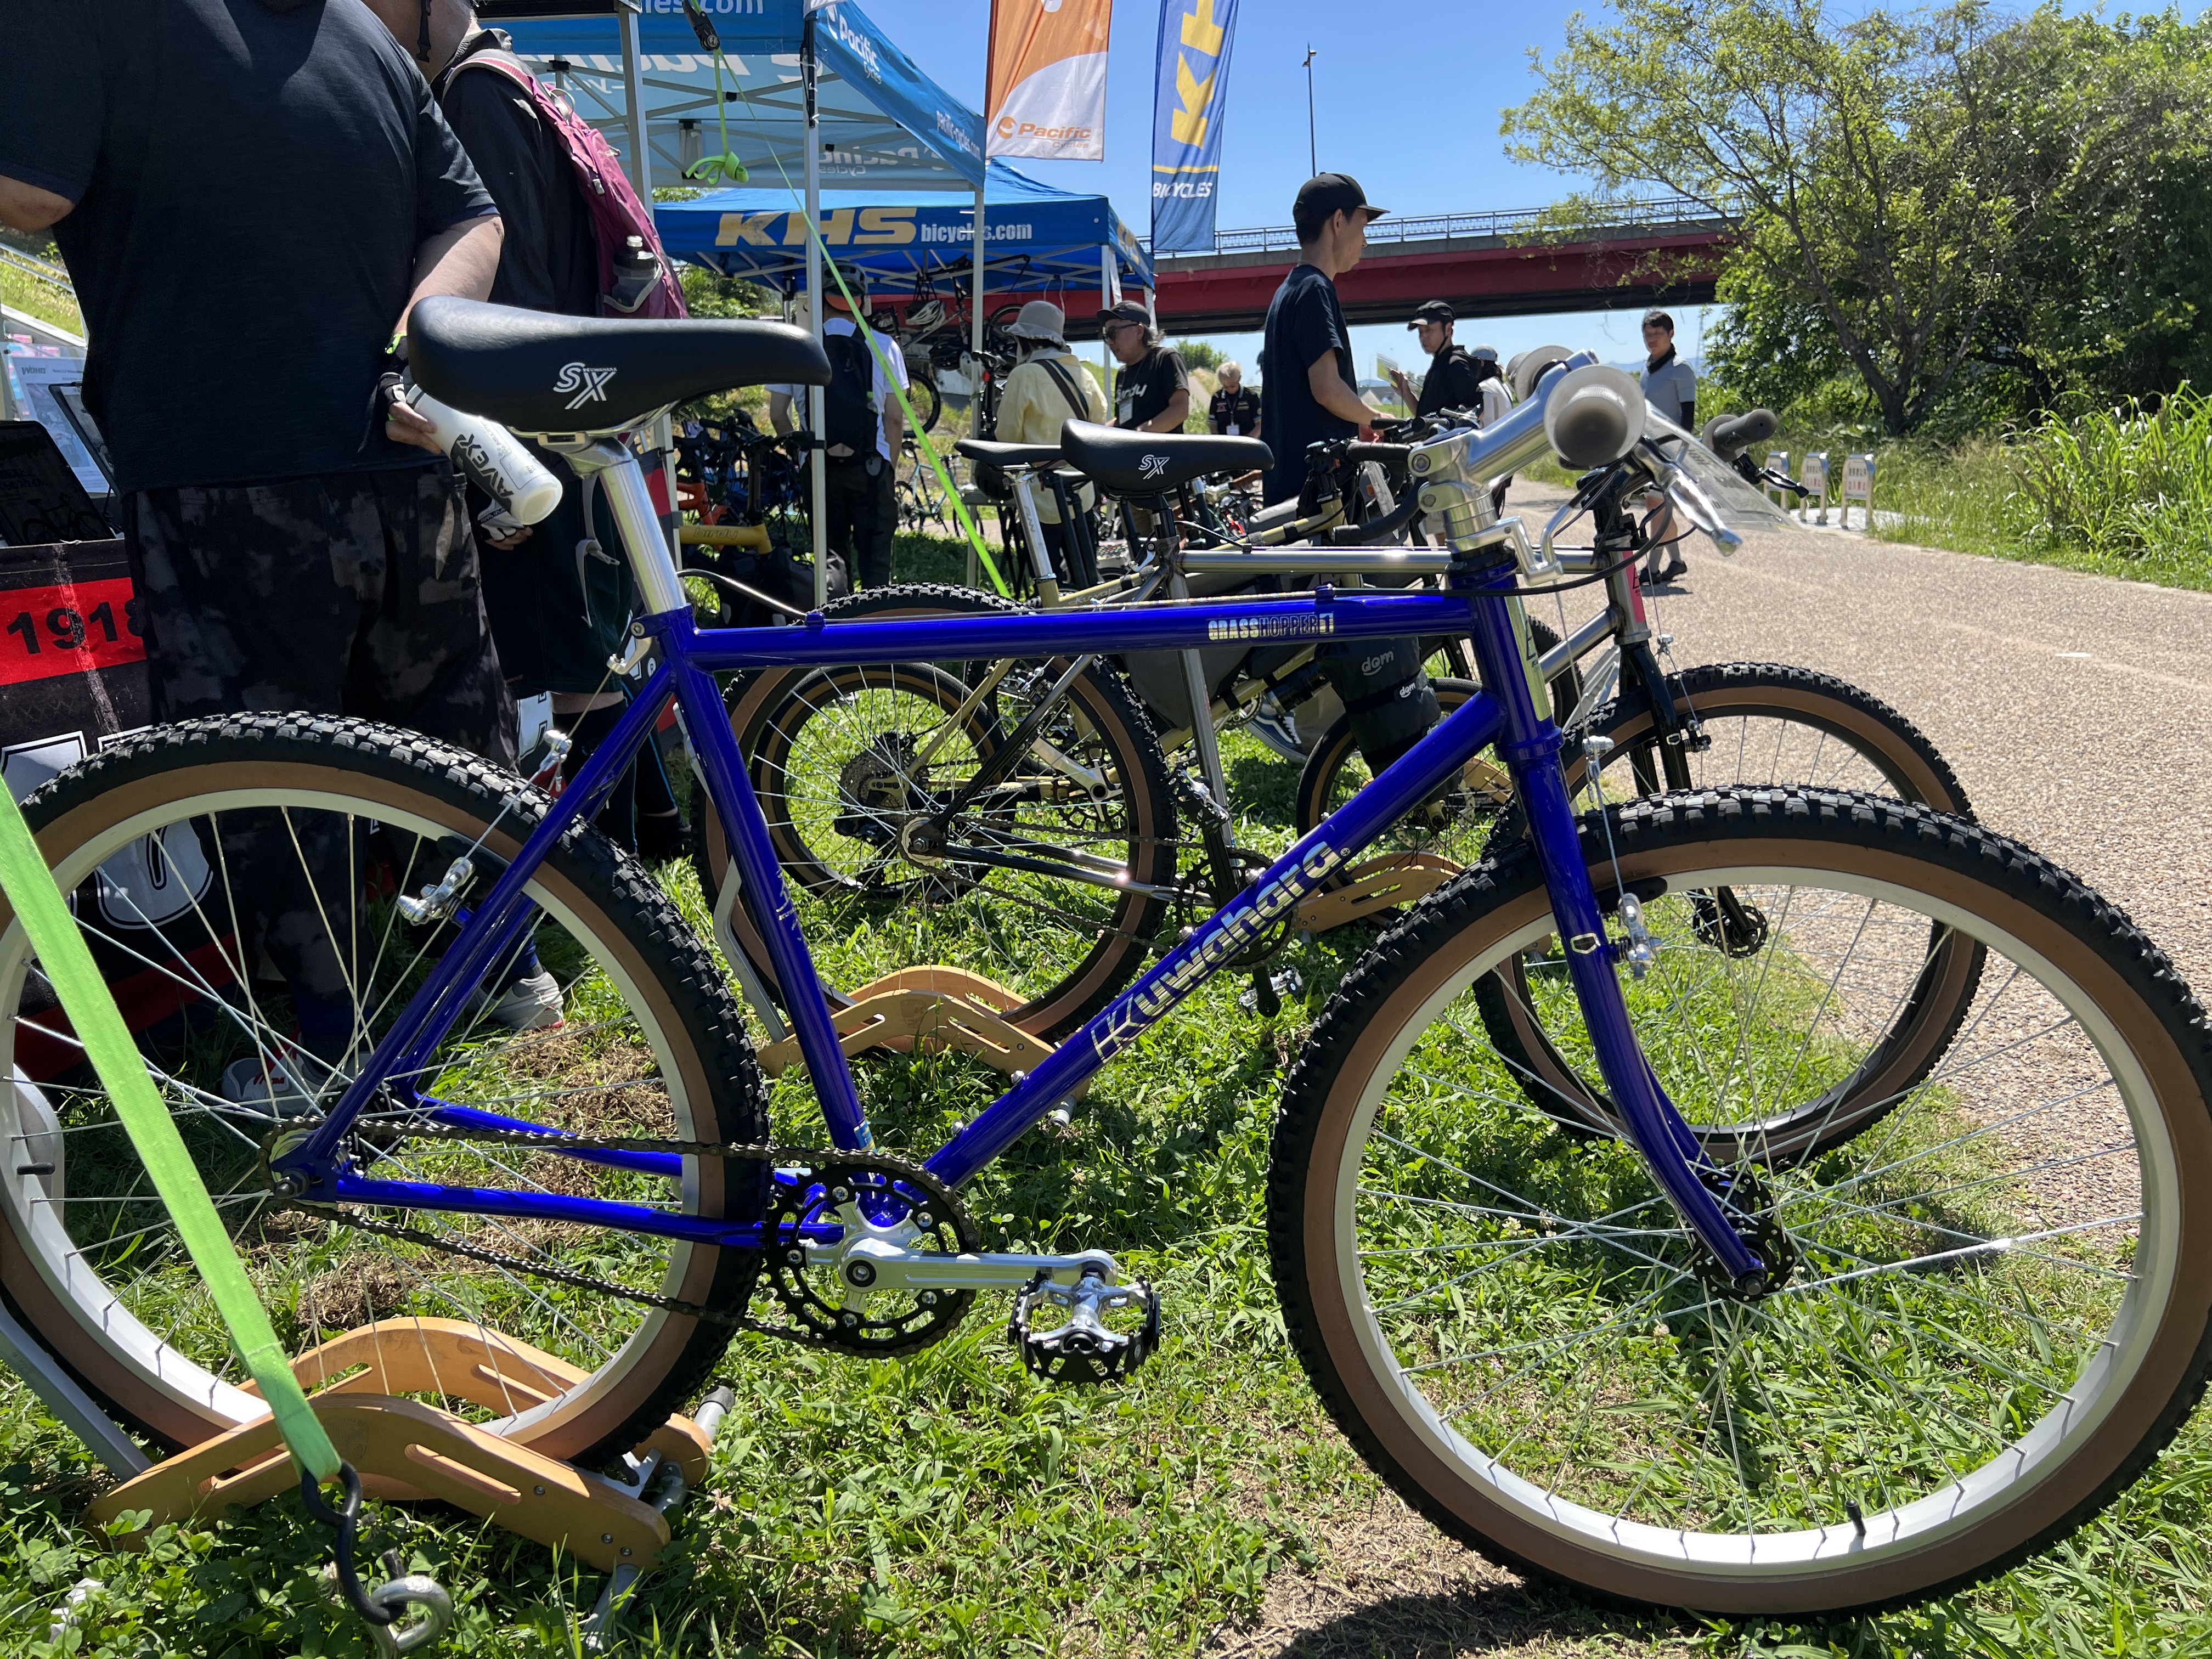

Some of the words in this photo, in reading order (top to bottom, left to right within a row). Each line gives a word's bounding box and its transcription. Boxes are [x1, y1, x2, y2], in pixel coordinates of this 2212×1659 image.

[839, 14, 880, 72] Pacific
[1017, 122, 1092, 139] Pacific
[1052, 141, 1090, 149] Cycles
[1152, 182, 1214, 199] BICYCLES
[715, 207, 917, 246] KHS
[921, 223, 1032, 242] bicycls.com
[1208, 615, 1318, 640] GRASSHOPPER
[1361, 651, 1395, 676] dom
[1400, 682, 1417, 698] dom
[1091, 840, 1344, 1064] Kuwahara
